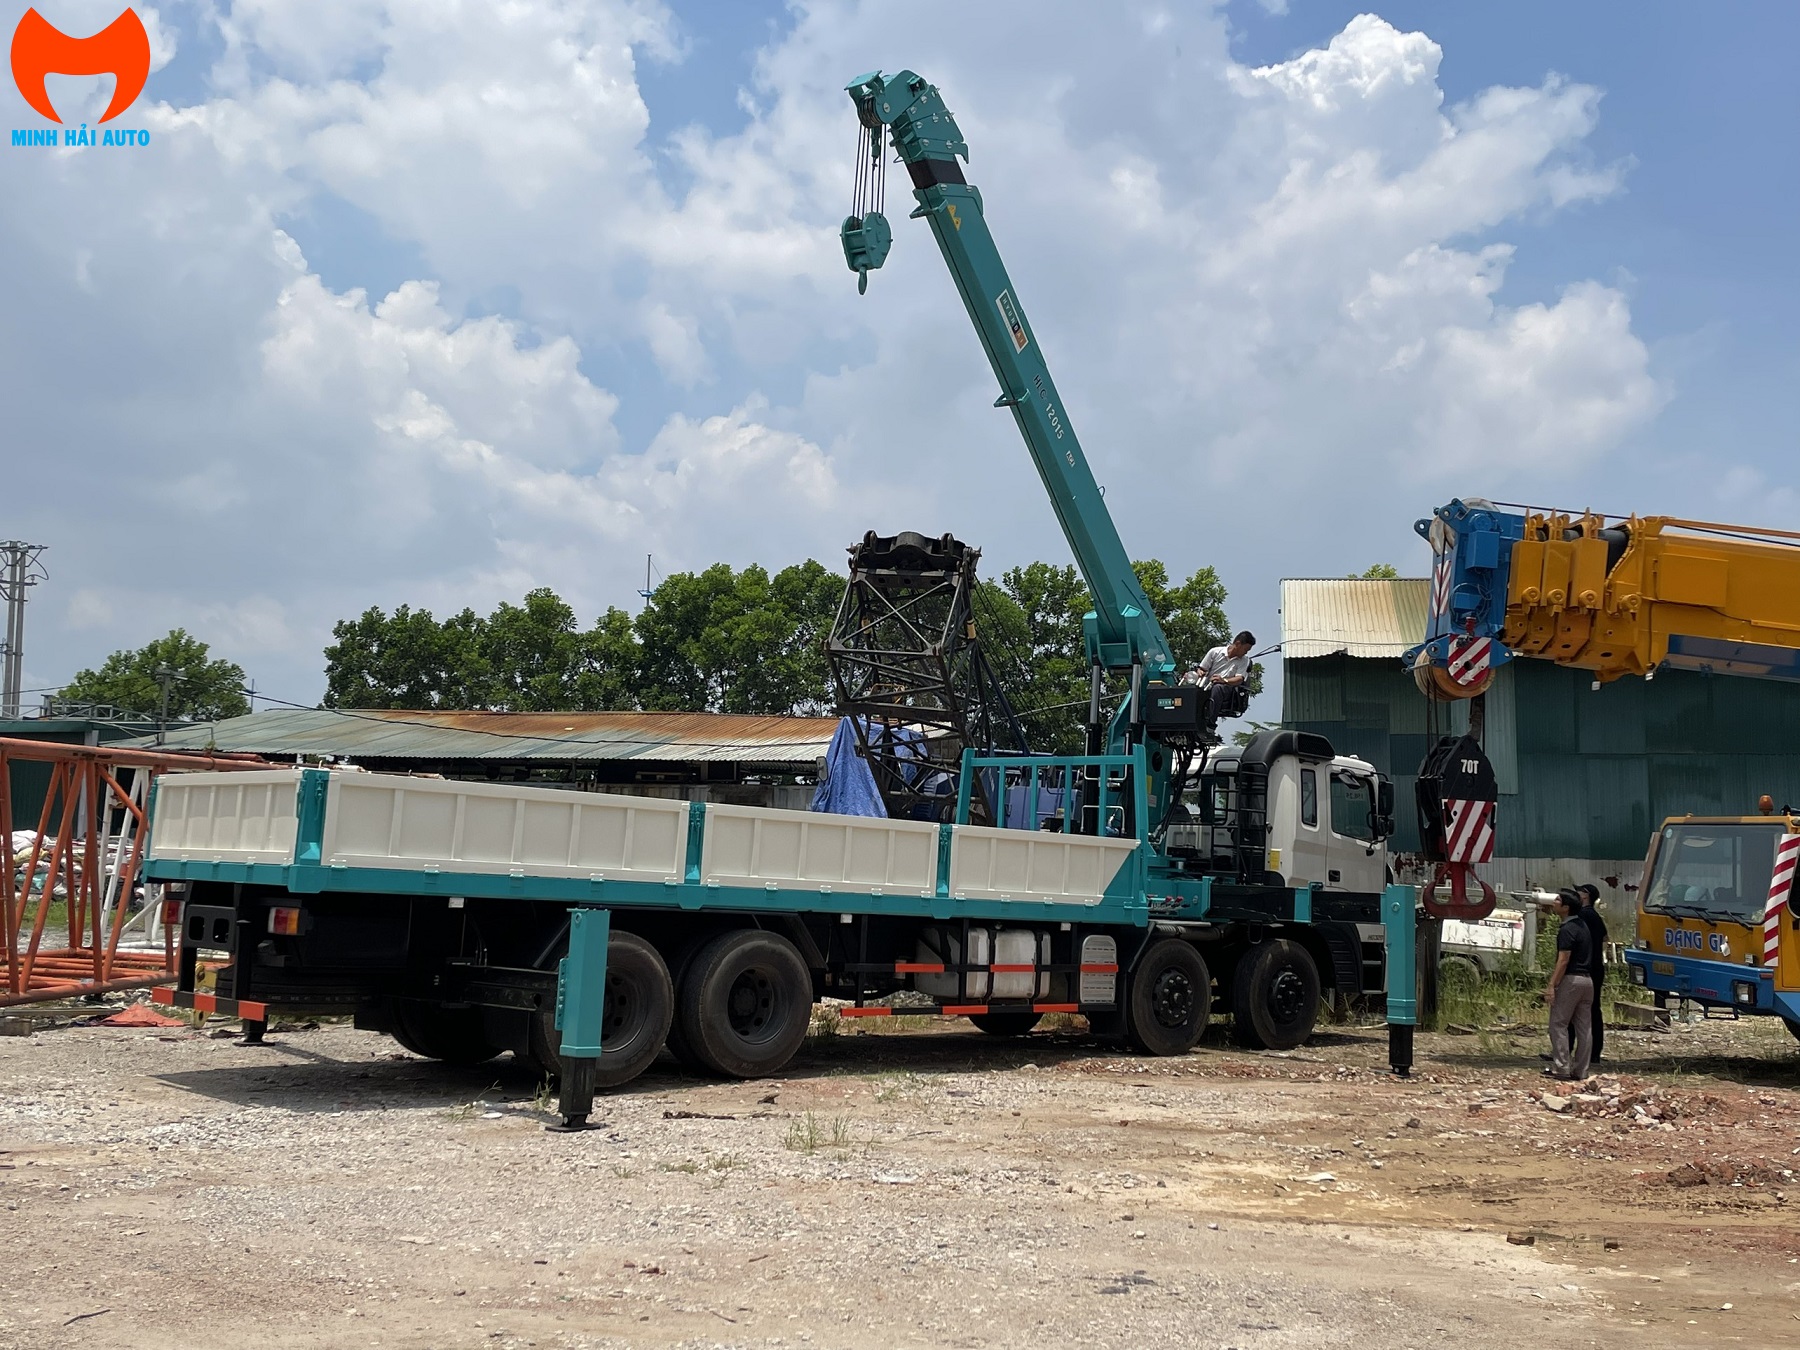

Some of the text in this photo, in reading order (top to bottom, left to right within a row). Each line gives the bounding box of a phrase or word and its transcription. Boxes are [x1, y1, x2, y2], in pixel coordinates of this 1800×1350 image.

[1001, 297, 1025, 344] HYUNDAI
[1045, 402, 1065, 440] 12015
[1460, 758, 1480, 775] 70T
[1708, 933, 1727, 954] GI
